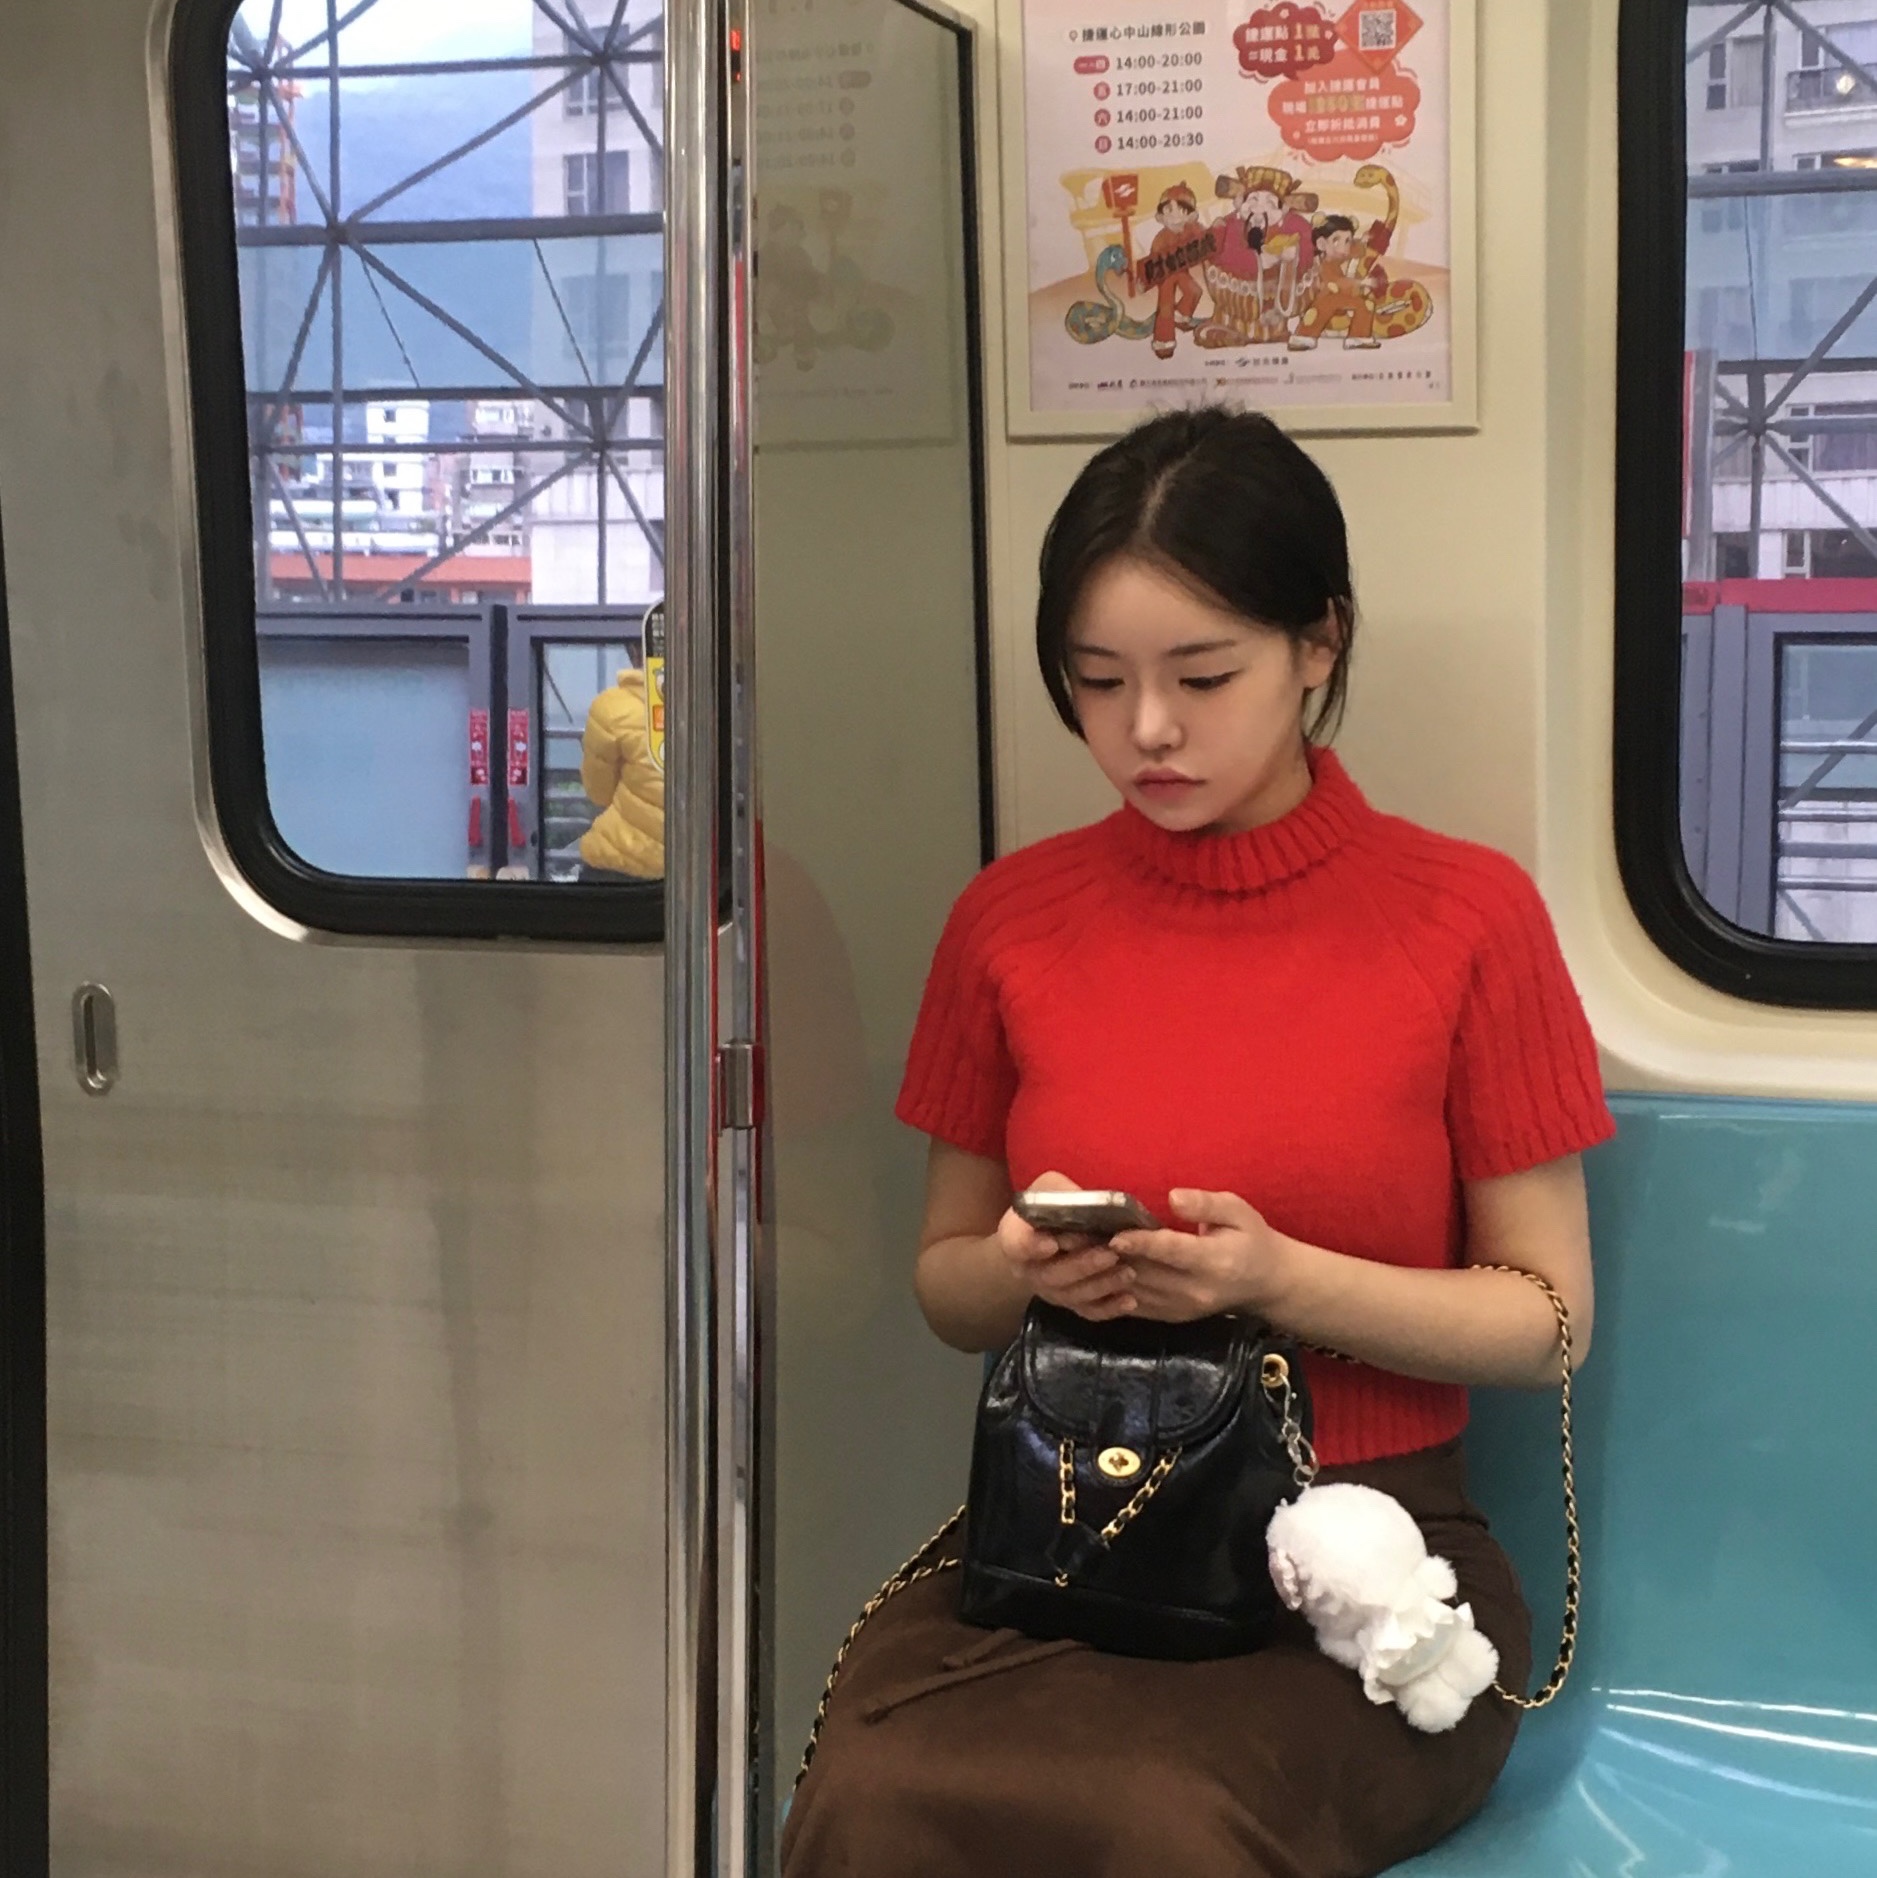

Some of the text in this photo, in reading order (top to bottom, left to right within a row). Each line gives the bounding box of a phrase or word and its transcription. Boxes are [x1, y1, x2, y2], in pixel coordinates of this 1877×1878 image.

[1082, 20, 1206, 42] 捷運心中山線形公園
[1116, 52, 1203, 70] 14:00-20:00
[1116, 79, 1203, 97] 17:00-21:00
[1116, 105, 1204, 123] 14:00-21:00
[1117, 132, 1204, 150] 14:00-20:30
